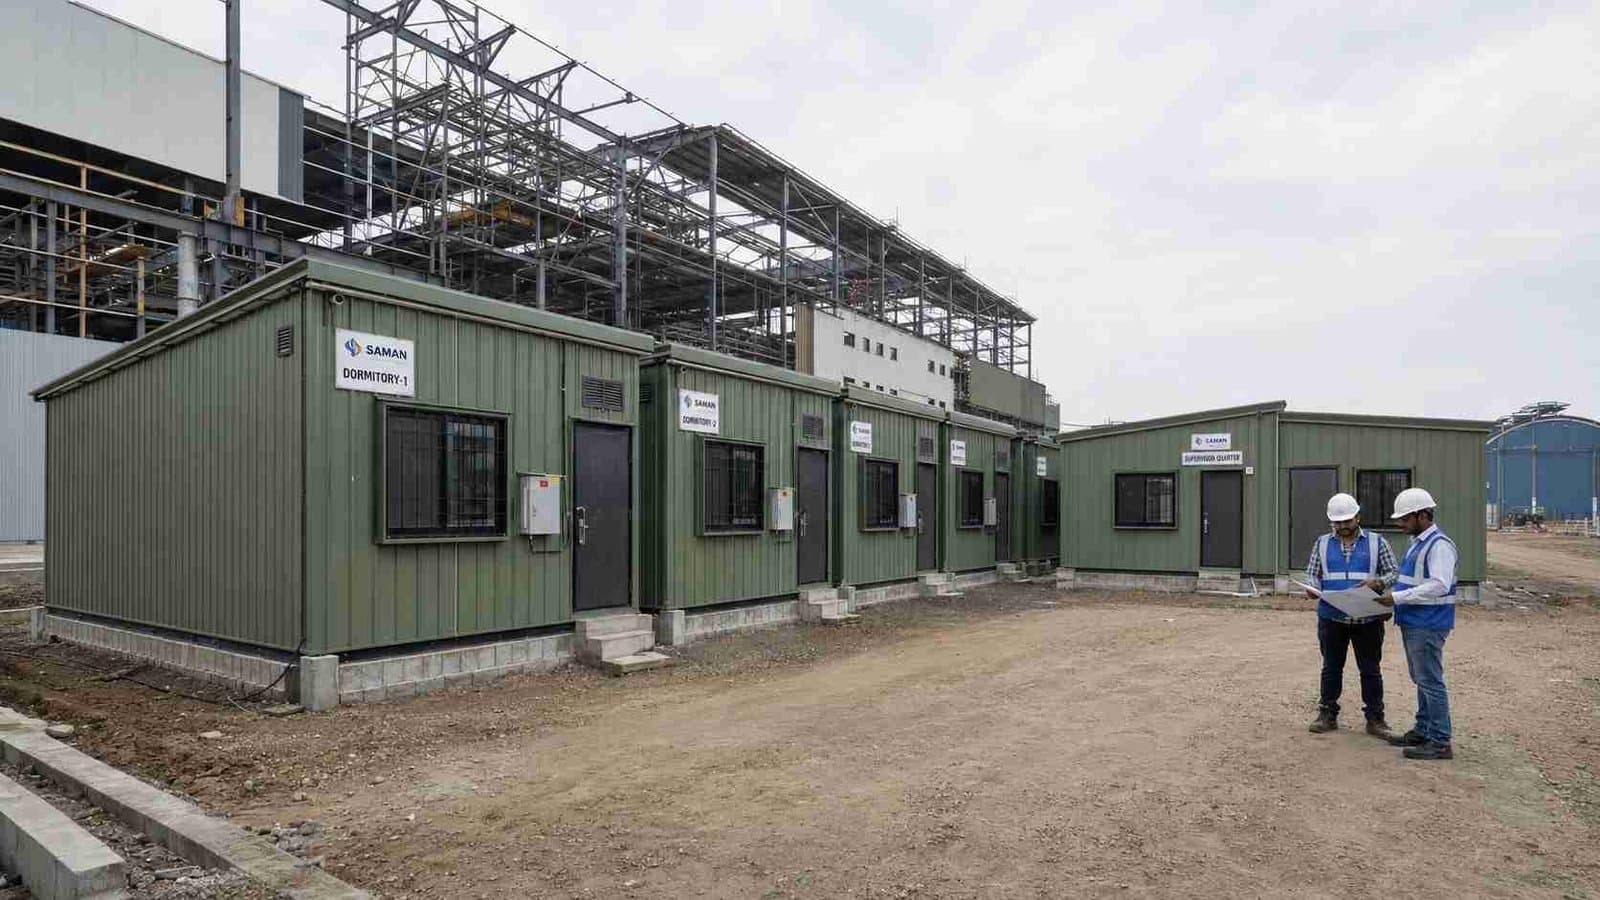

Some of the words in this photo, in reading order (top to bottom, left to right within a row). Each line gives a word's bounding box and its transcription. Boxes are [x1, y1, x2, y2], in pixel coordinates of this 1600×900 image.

[366, 344, 407, 360] SAMAN
[343, 367, 408, 387] DORMITORY-1
[694, 399, 716, 409] SAMAN
